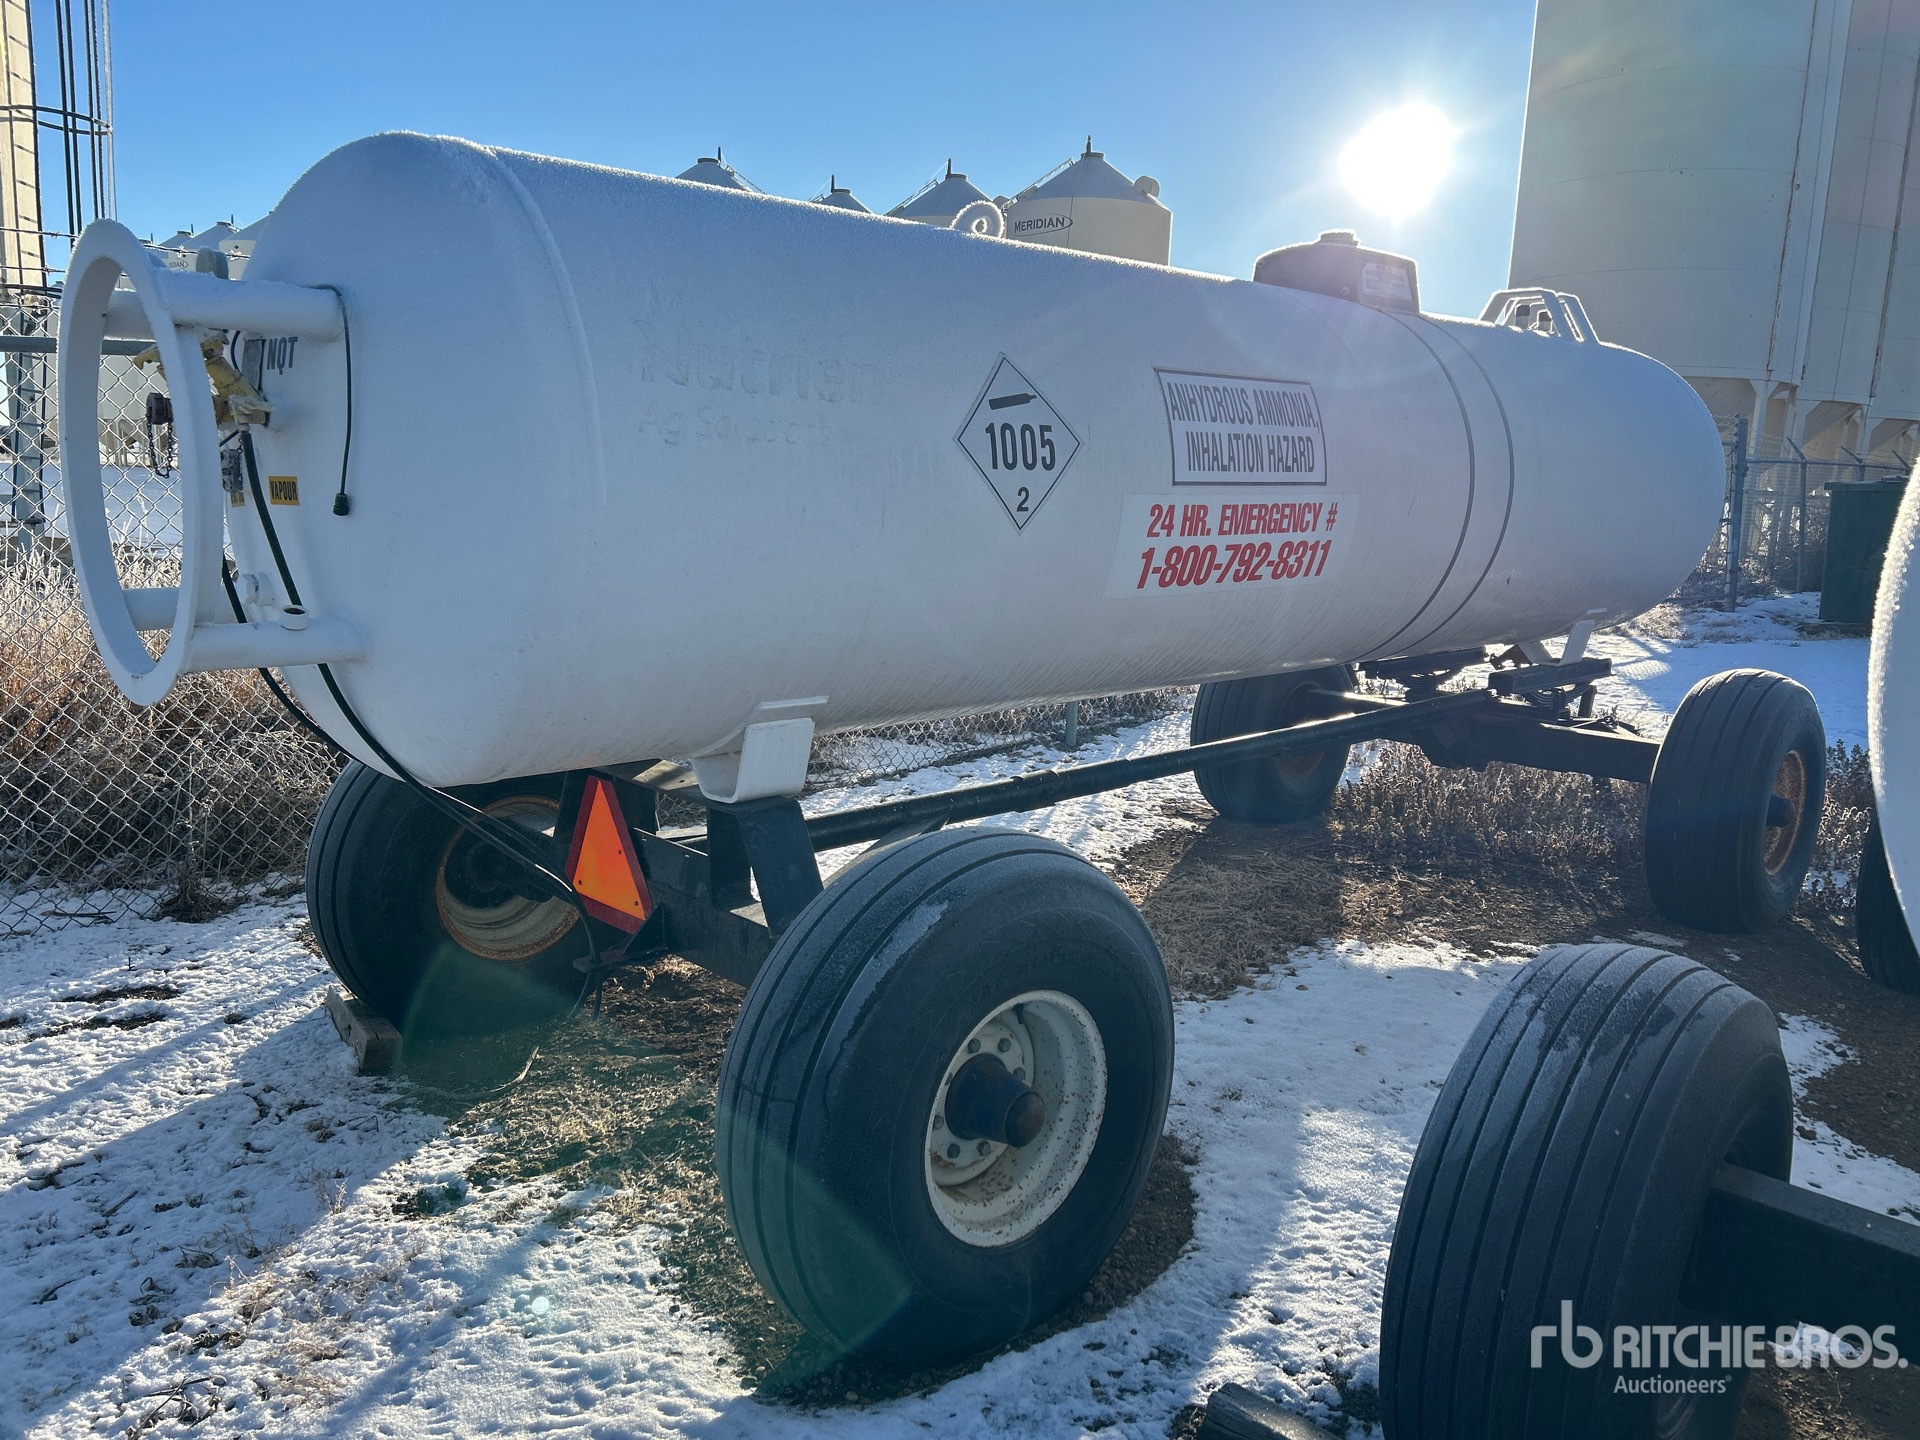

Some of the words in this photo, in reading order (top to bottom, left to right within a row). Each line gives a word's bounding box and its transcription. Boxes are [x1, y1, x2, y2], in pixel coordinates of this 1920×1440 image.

[1014, 217, 1065, 233] MERIDIAN
[1166, 382, 1254, 425] ANHYDROUS
[985, 422, 1056, 471] 1005
[1185, 431, 1265, 473] INHALATION
[1266, 434, 1315, 473] HAZARD
[269, 480, 298, 501] VAPOUR
[1016, 486, 1030, 512] 2
[1146, 503, 1176, 538] 24
[1179, 503, 1212, 537] HR.
[1217, 502, 1324, 536] EMERGENCY
[1325, 502, 1339, 532] #
[1136, 539, 1333, 590] 1-800-792-8311
